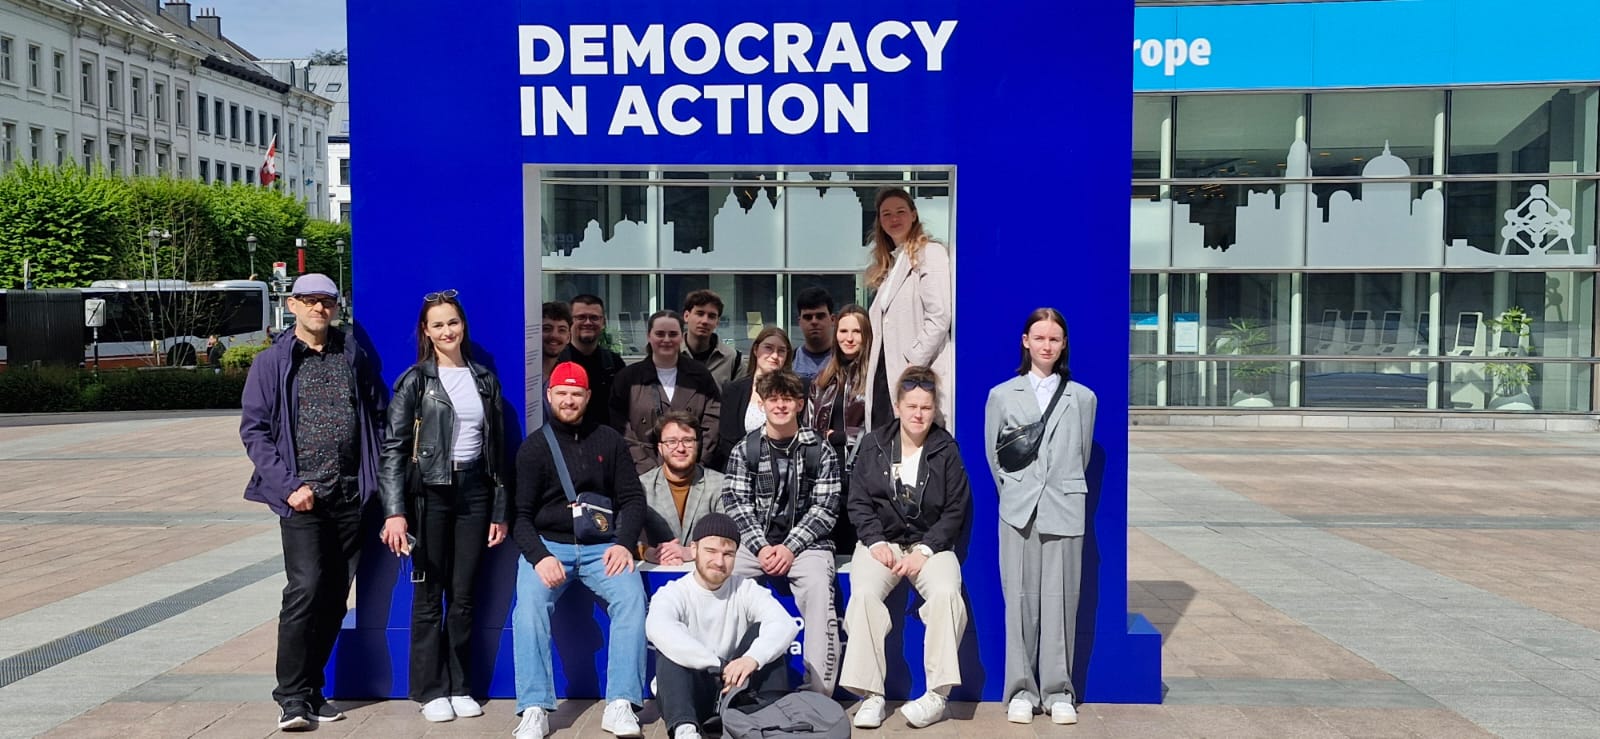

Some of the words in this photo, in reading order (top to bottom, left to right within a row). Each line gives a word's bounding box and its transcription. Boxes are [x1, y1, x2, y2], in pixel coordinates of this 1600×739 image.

[518, 20, 958, 75] DEMOCRACY
[520, 85, 587, 136] IN
[607, 82, 869, 135] ACTION
